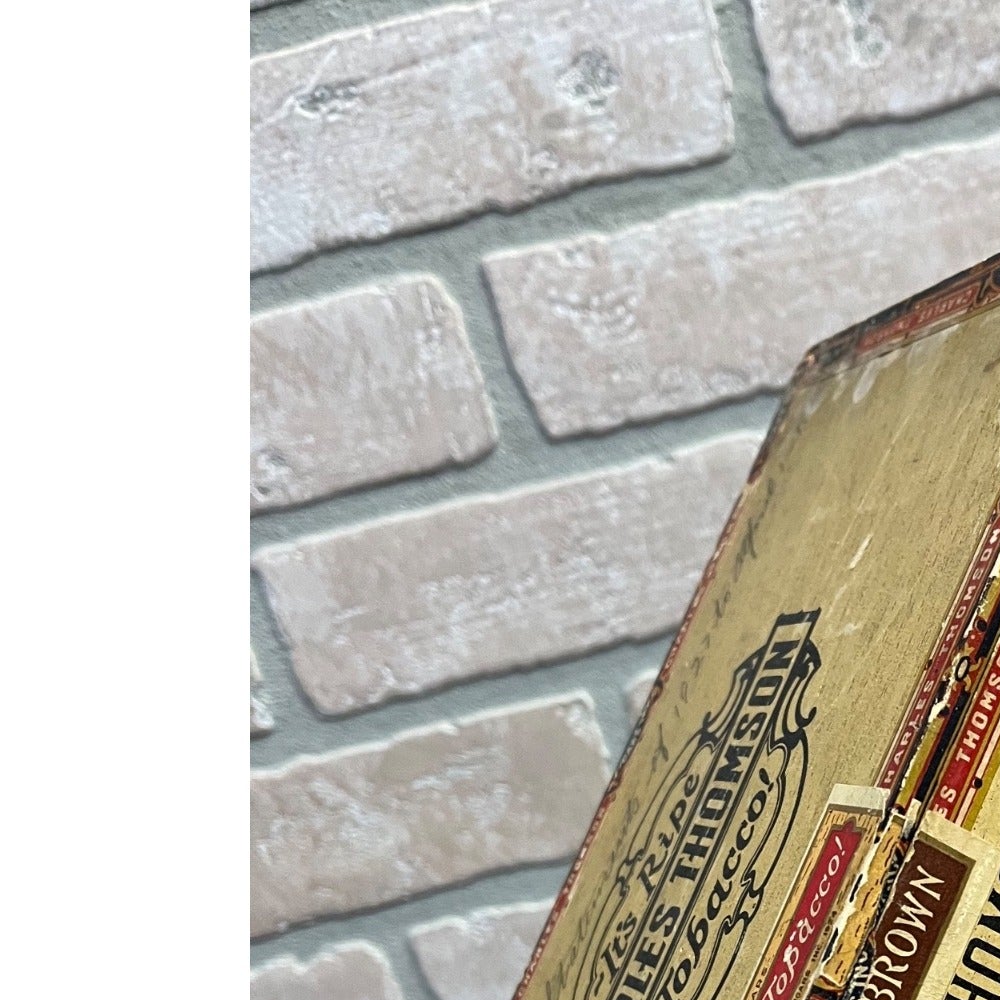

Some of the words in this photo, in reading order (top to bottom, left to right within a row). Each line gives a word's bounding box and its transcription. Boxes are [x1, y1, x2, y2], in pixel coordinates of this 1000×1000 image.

[669, 639, 802, 882] THOMSON
[882, 679, 935, 785] HARLES
[599, 909, 642, 980] It's
[636, 769, 701, 896] Ripe
